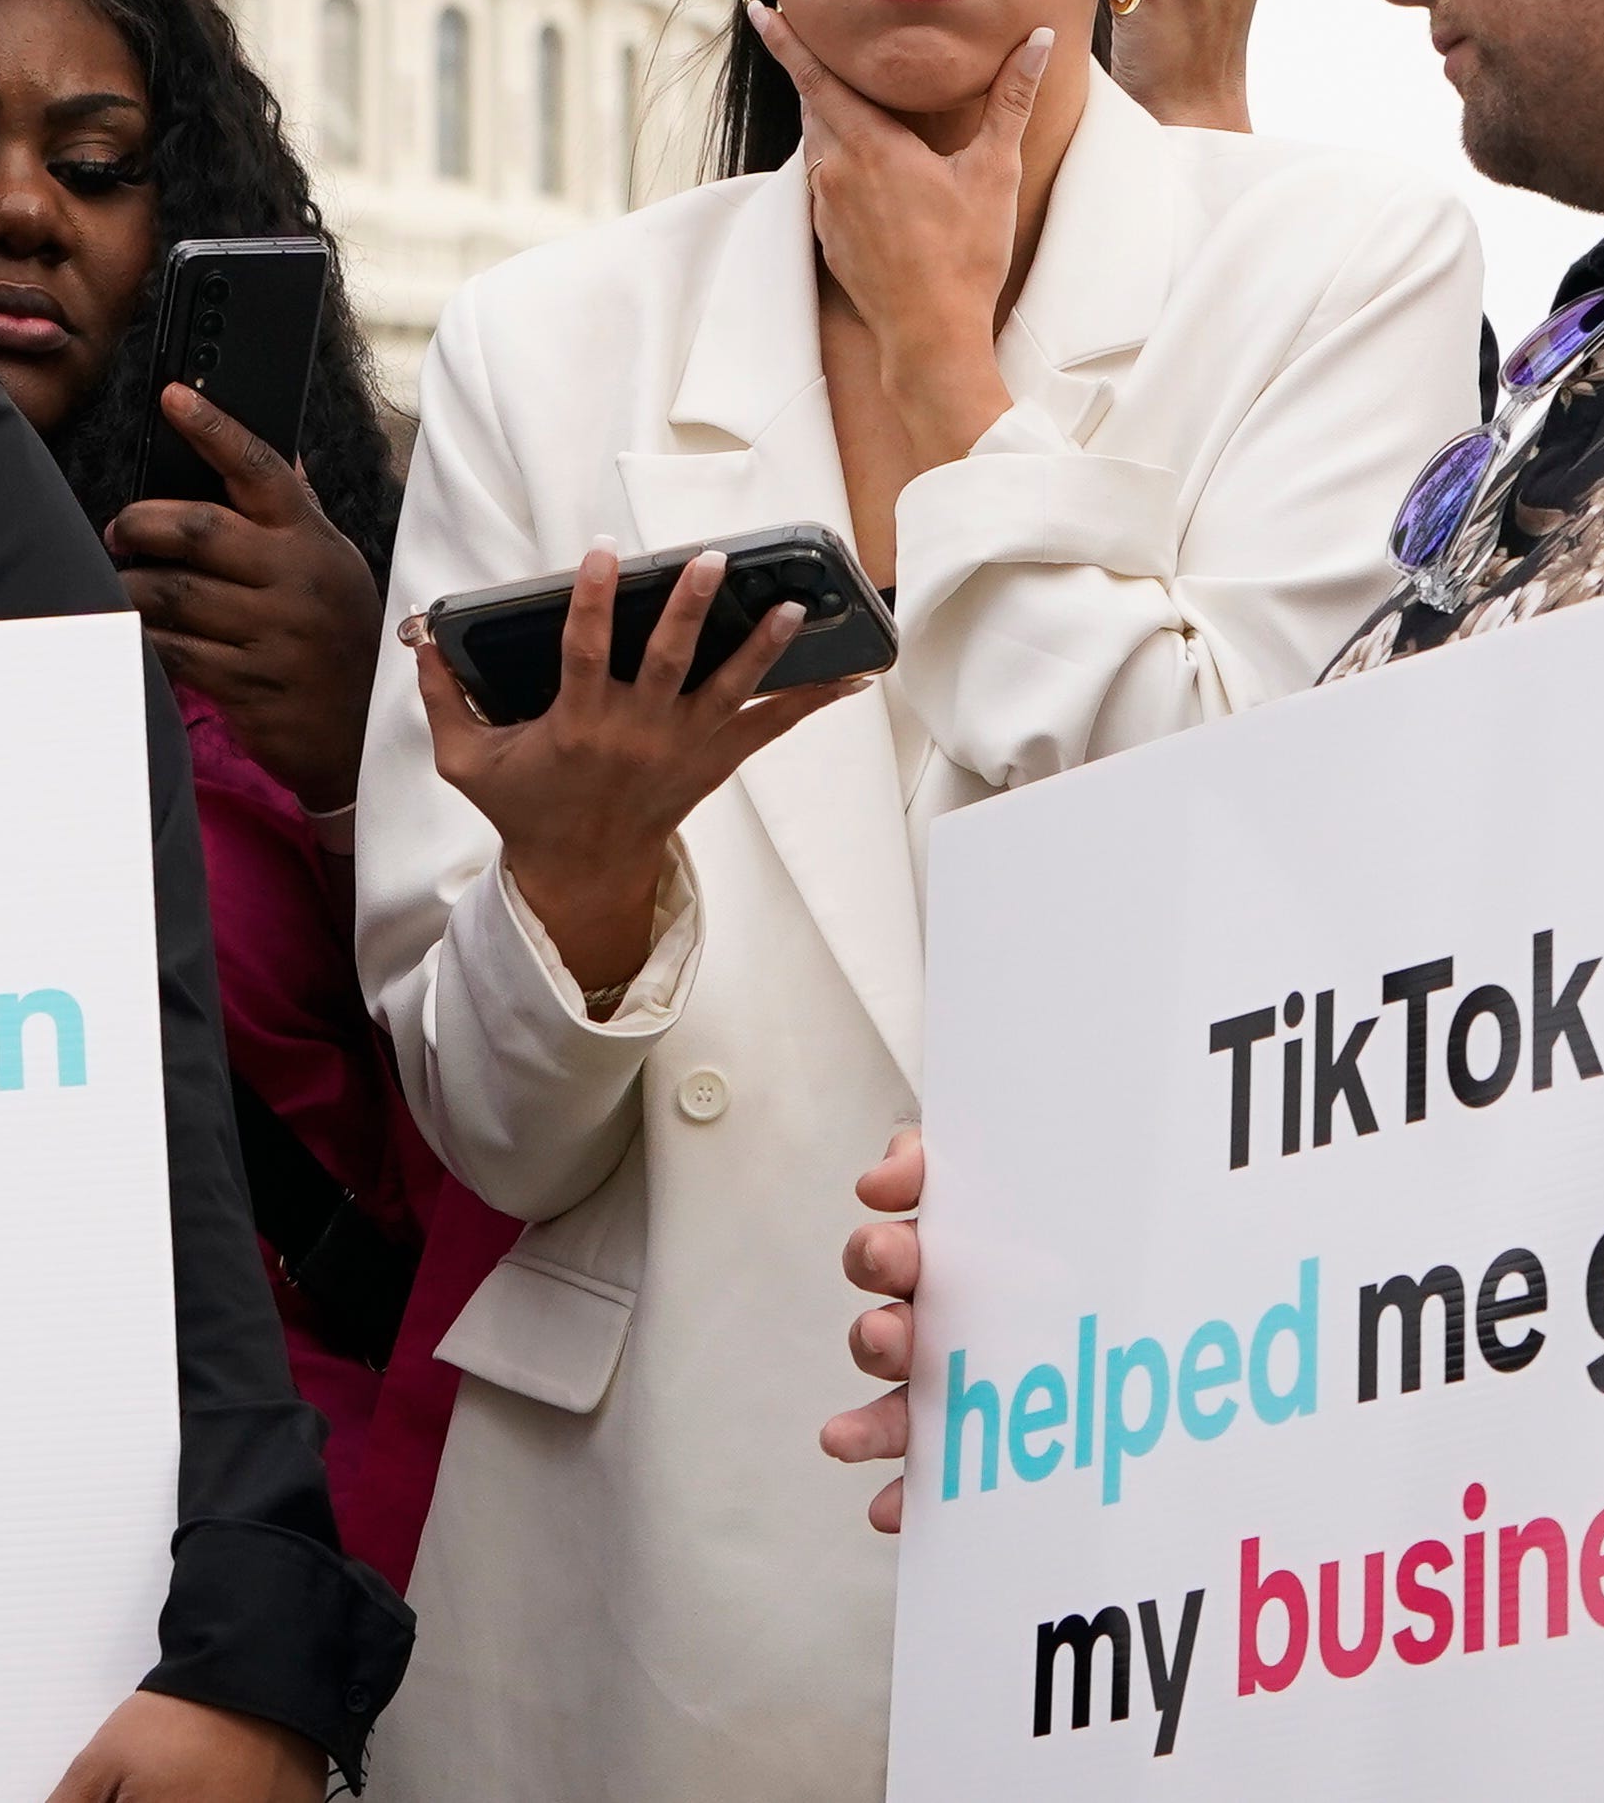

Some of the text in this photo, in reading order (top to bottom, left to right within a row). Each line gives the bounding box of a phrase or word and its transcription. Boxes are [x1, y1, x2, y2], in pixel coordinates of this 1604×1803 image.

[1209, 929, 1604, 1171] TikTok
[941, 1257, 1319, 1505] helped
[1358, 1248, 1548, 1404] me
[1033, 1588, 1205, 1758] my
